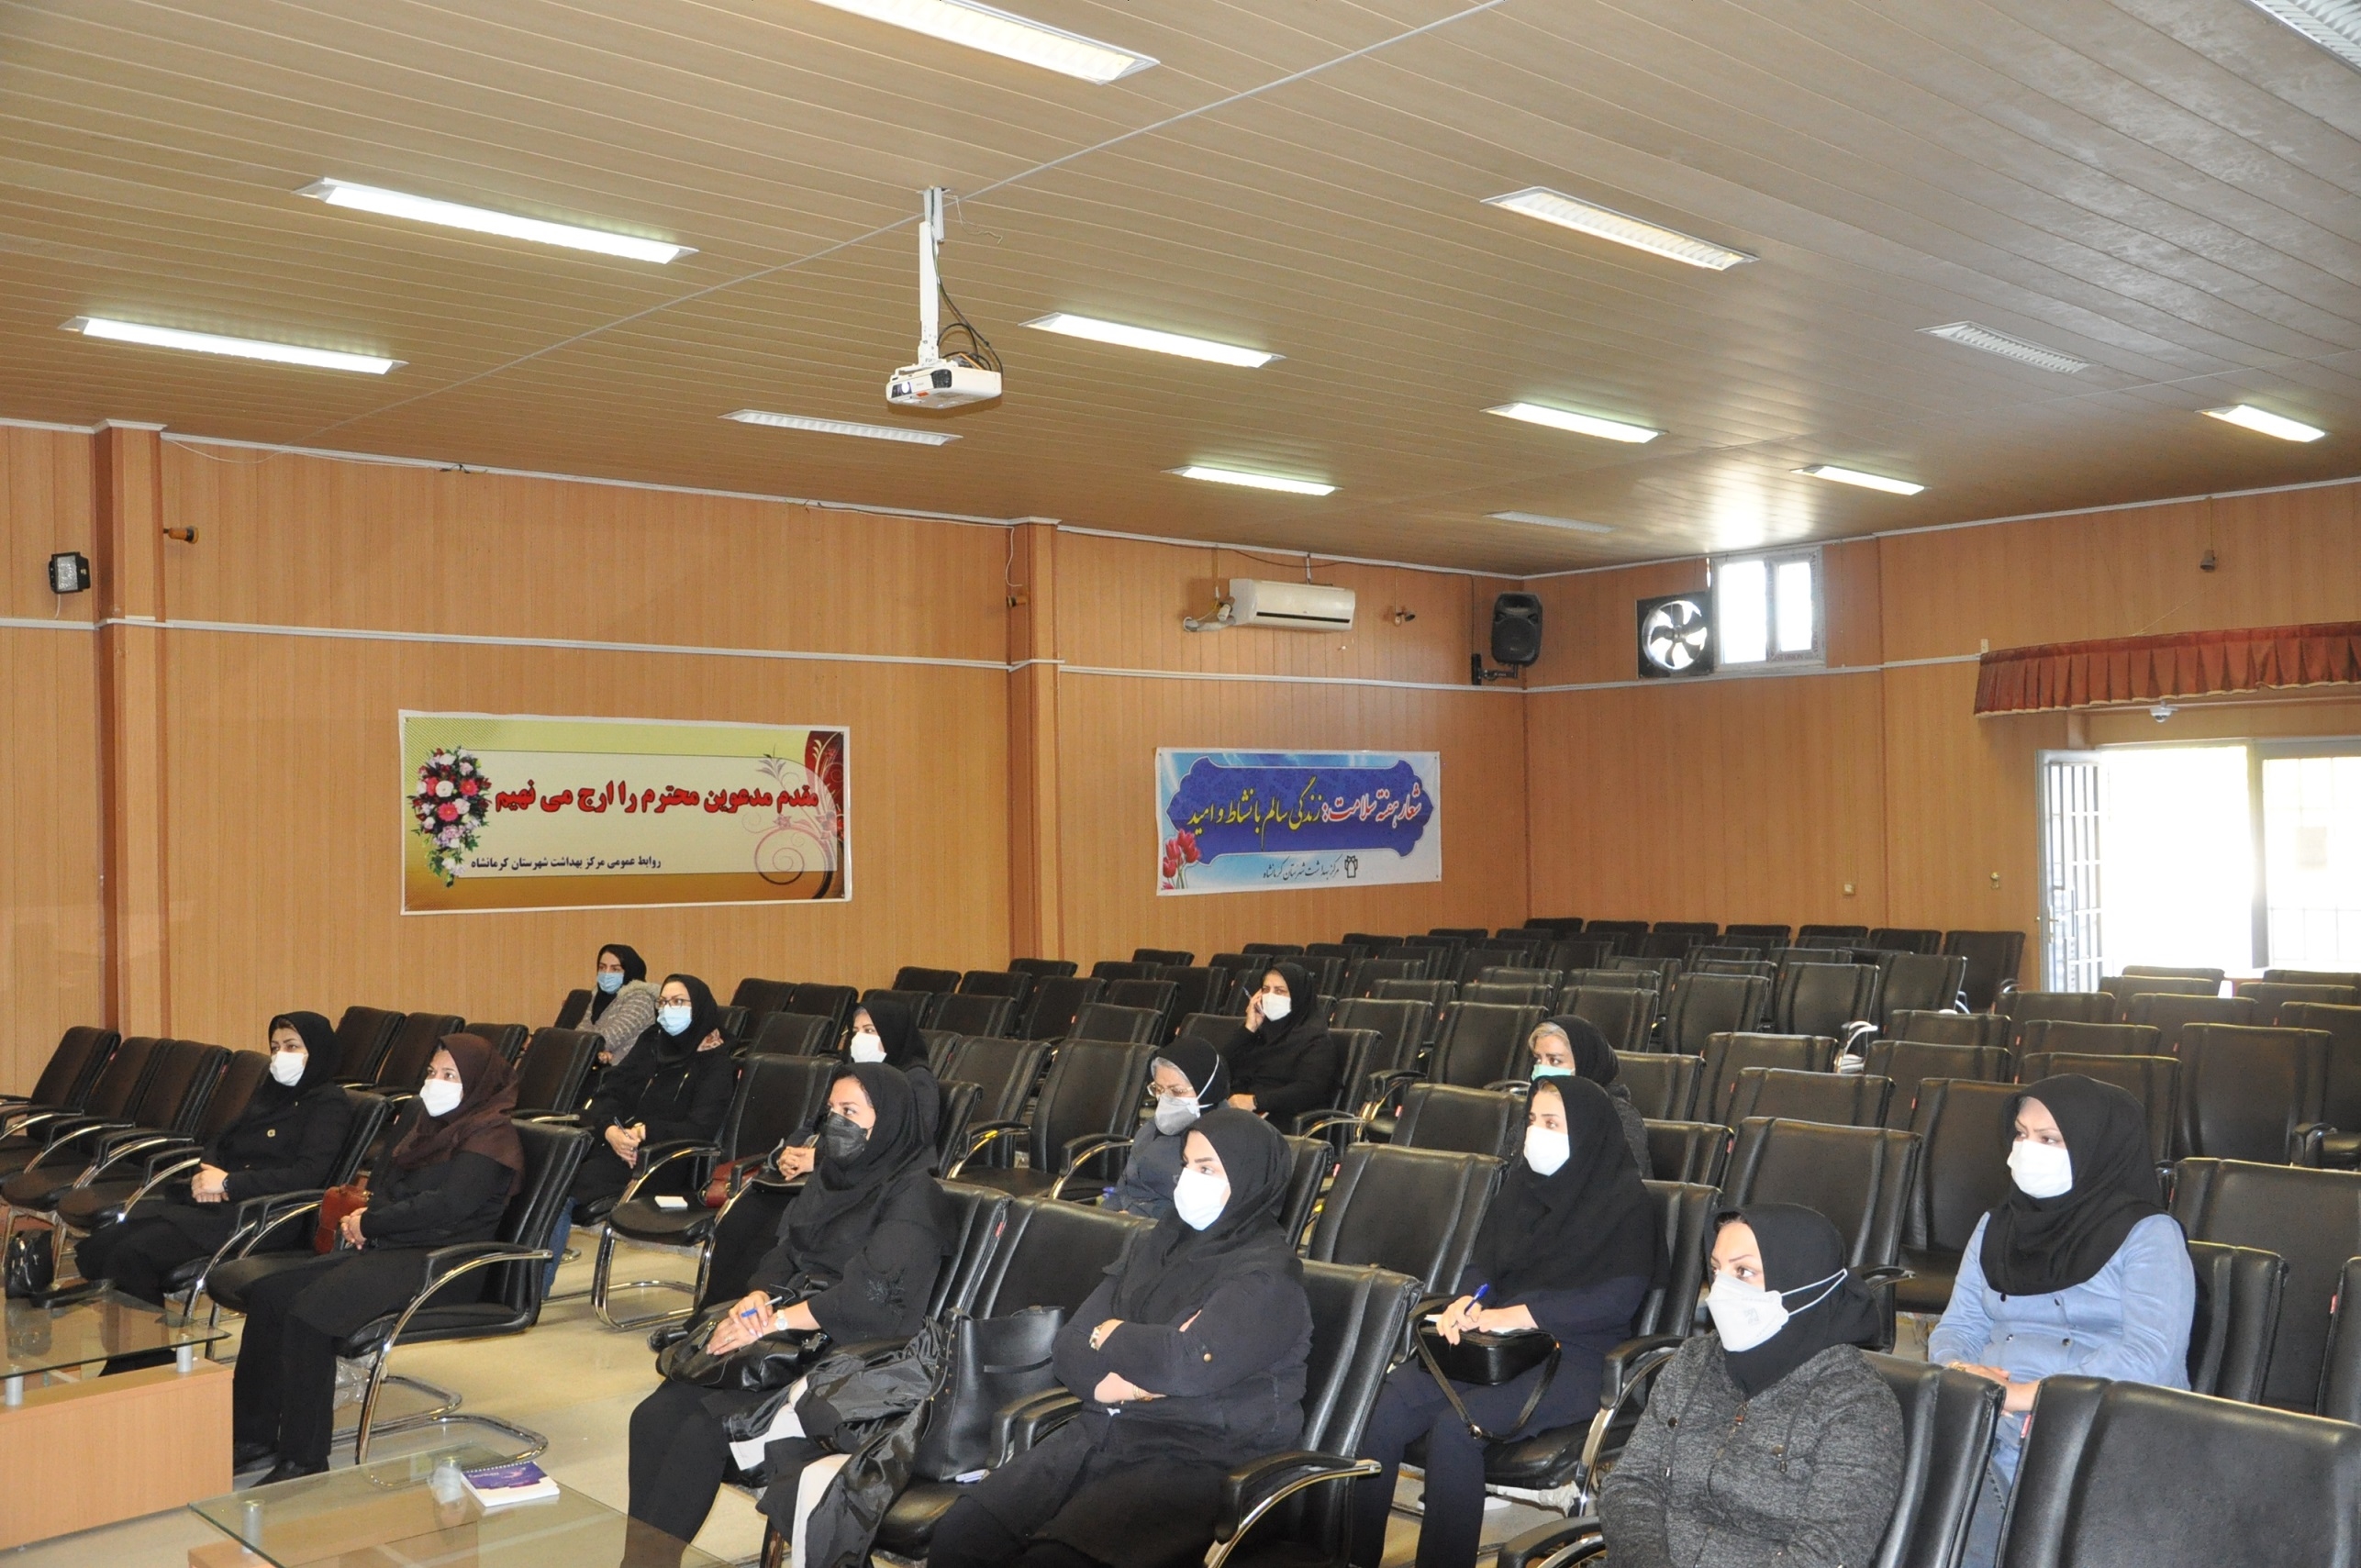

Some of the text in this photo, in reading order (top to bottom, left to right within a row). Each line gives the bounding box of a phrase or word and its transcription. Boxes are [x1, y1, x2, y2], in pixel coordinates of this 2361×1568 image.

[496, 779, 819, 814] مقدم مدعوین محترم را ارج می نهیم
[1288, 775, 1322, 830] زندگی
[1321, 793, 1377, 822] سلامت:
[1375, 788, 1399, 828] هفته
[1398, 782, 1421, 820] شعار
[1186, 803, 1214, 835] امید
[1216, 807, 1224, 823] و
[1261, 795, 1288, 851] سالم
[471, 855, 662, 871] روابط عمومی مرکز بهداشت شهرستان کرمانشاه
[1263, 853, 1342, 881] مرکز بهداشت شهرستان کرمانشاه
